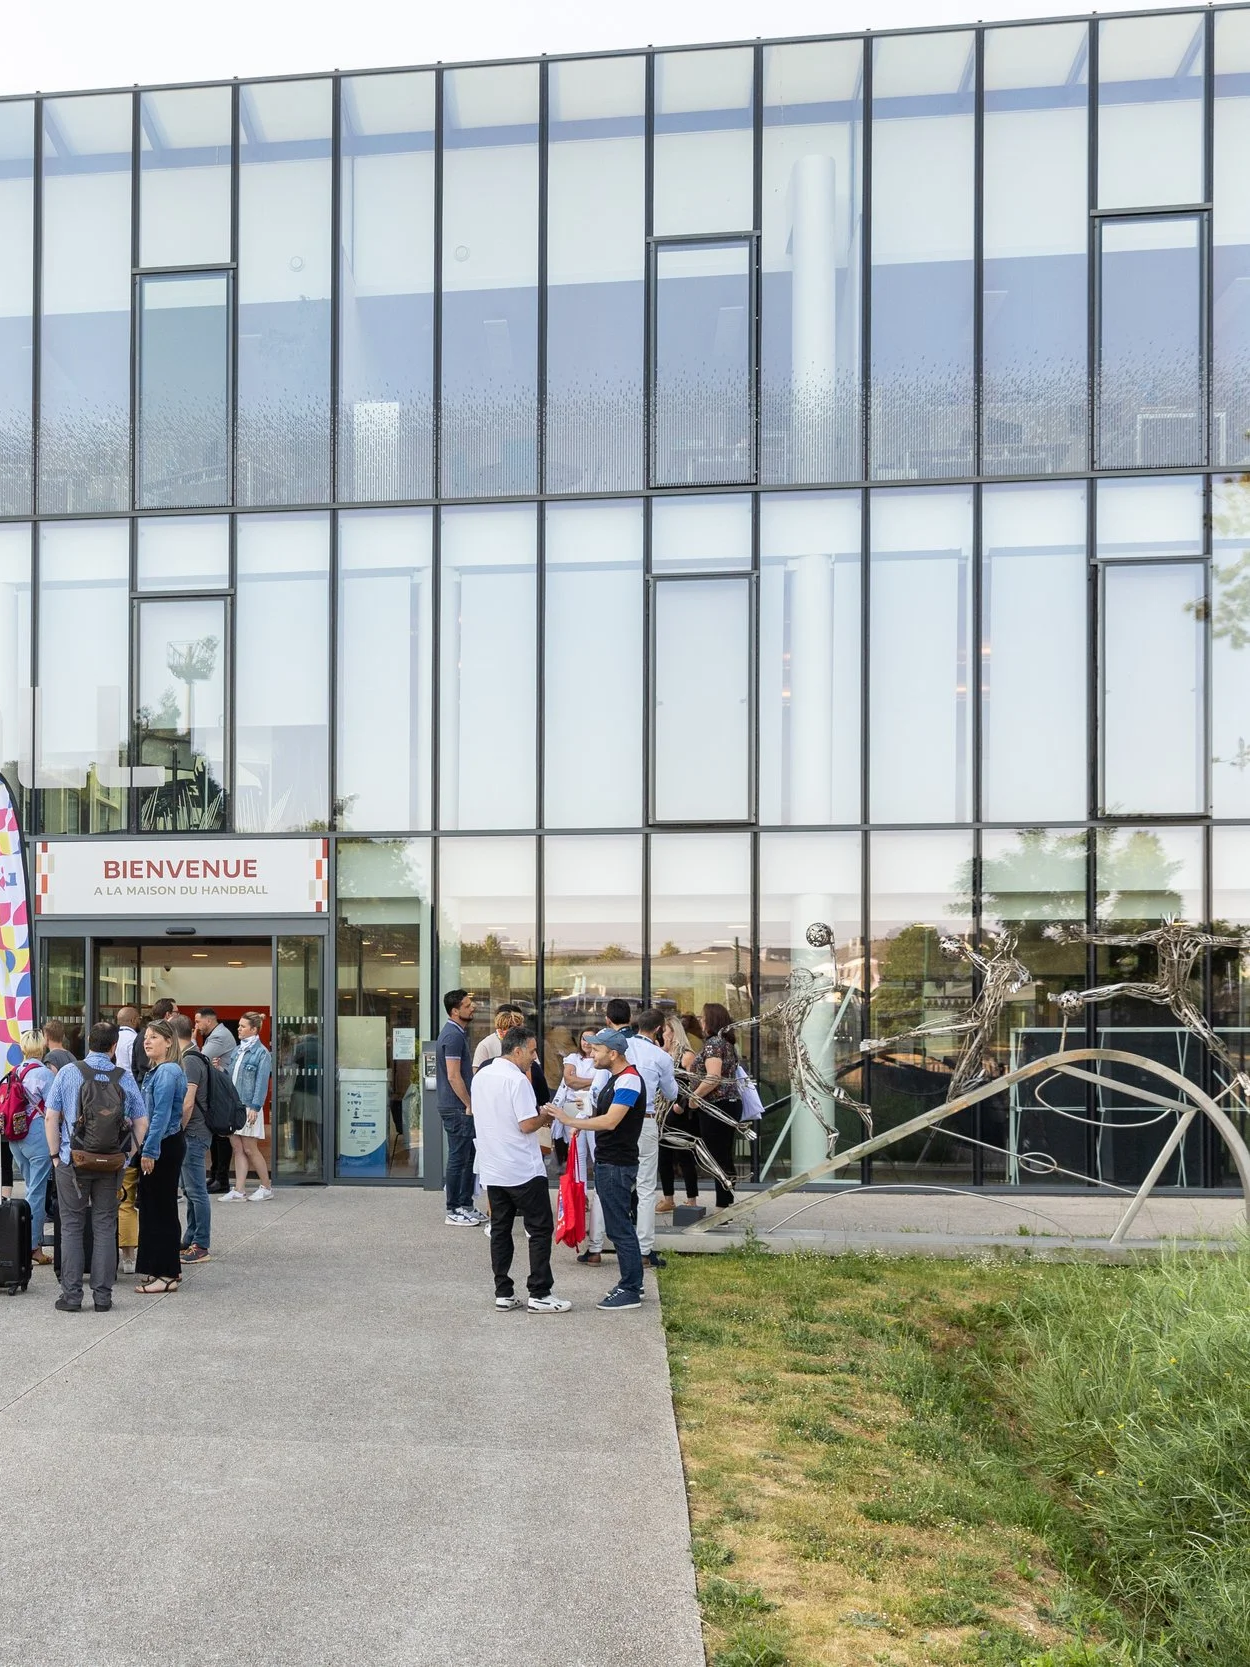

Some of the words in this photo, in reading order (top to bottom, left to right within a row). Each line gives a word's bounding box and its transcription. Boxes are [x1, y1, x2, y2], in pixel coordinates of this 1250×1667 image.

[104, 860, 257, 879] BIENVENUE
[94, 887, 102, 896] A
[106, 887, 122, 896] LA
[126, 886, 176, 896] MAISON
[180, 886, 197, 895] DU
[201, 885, 268, 895] HANDBALL
